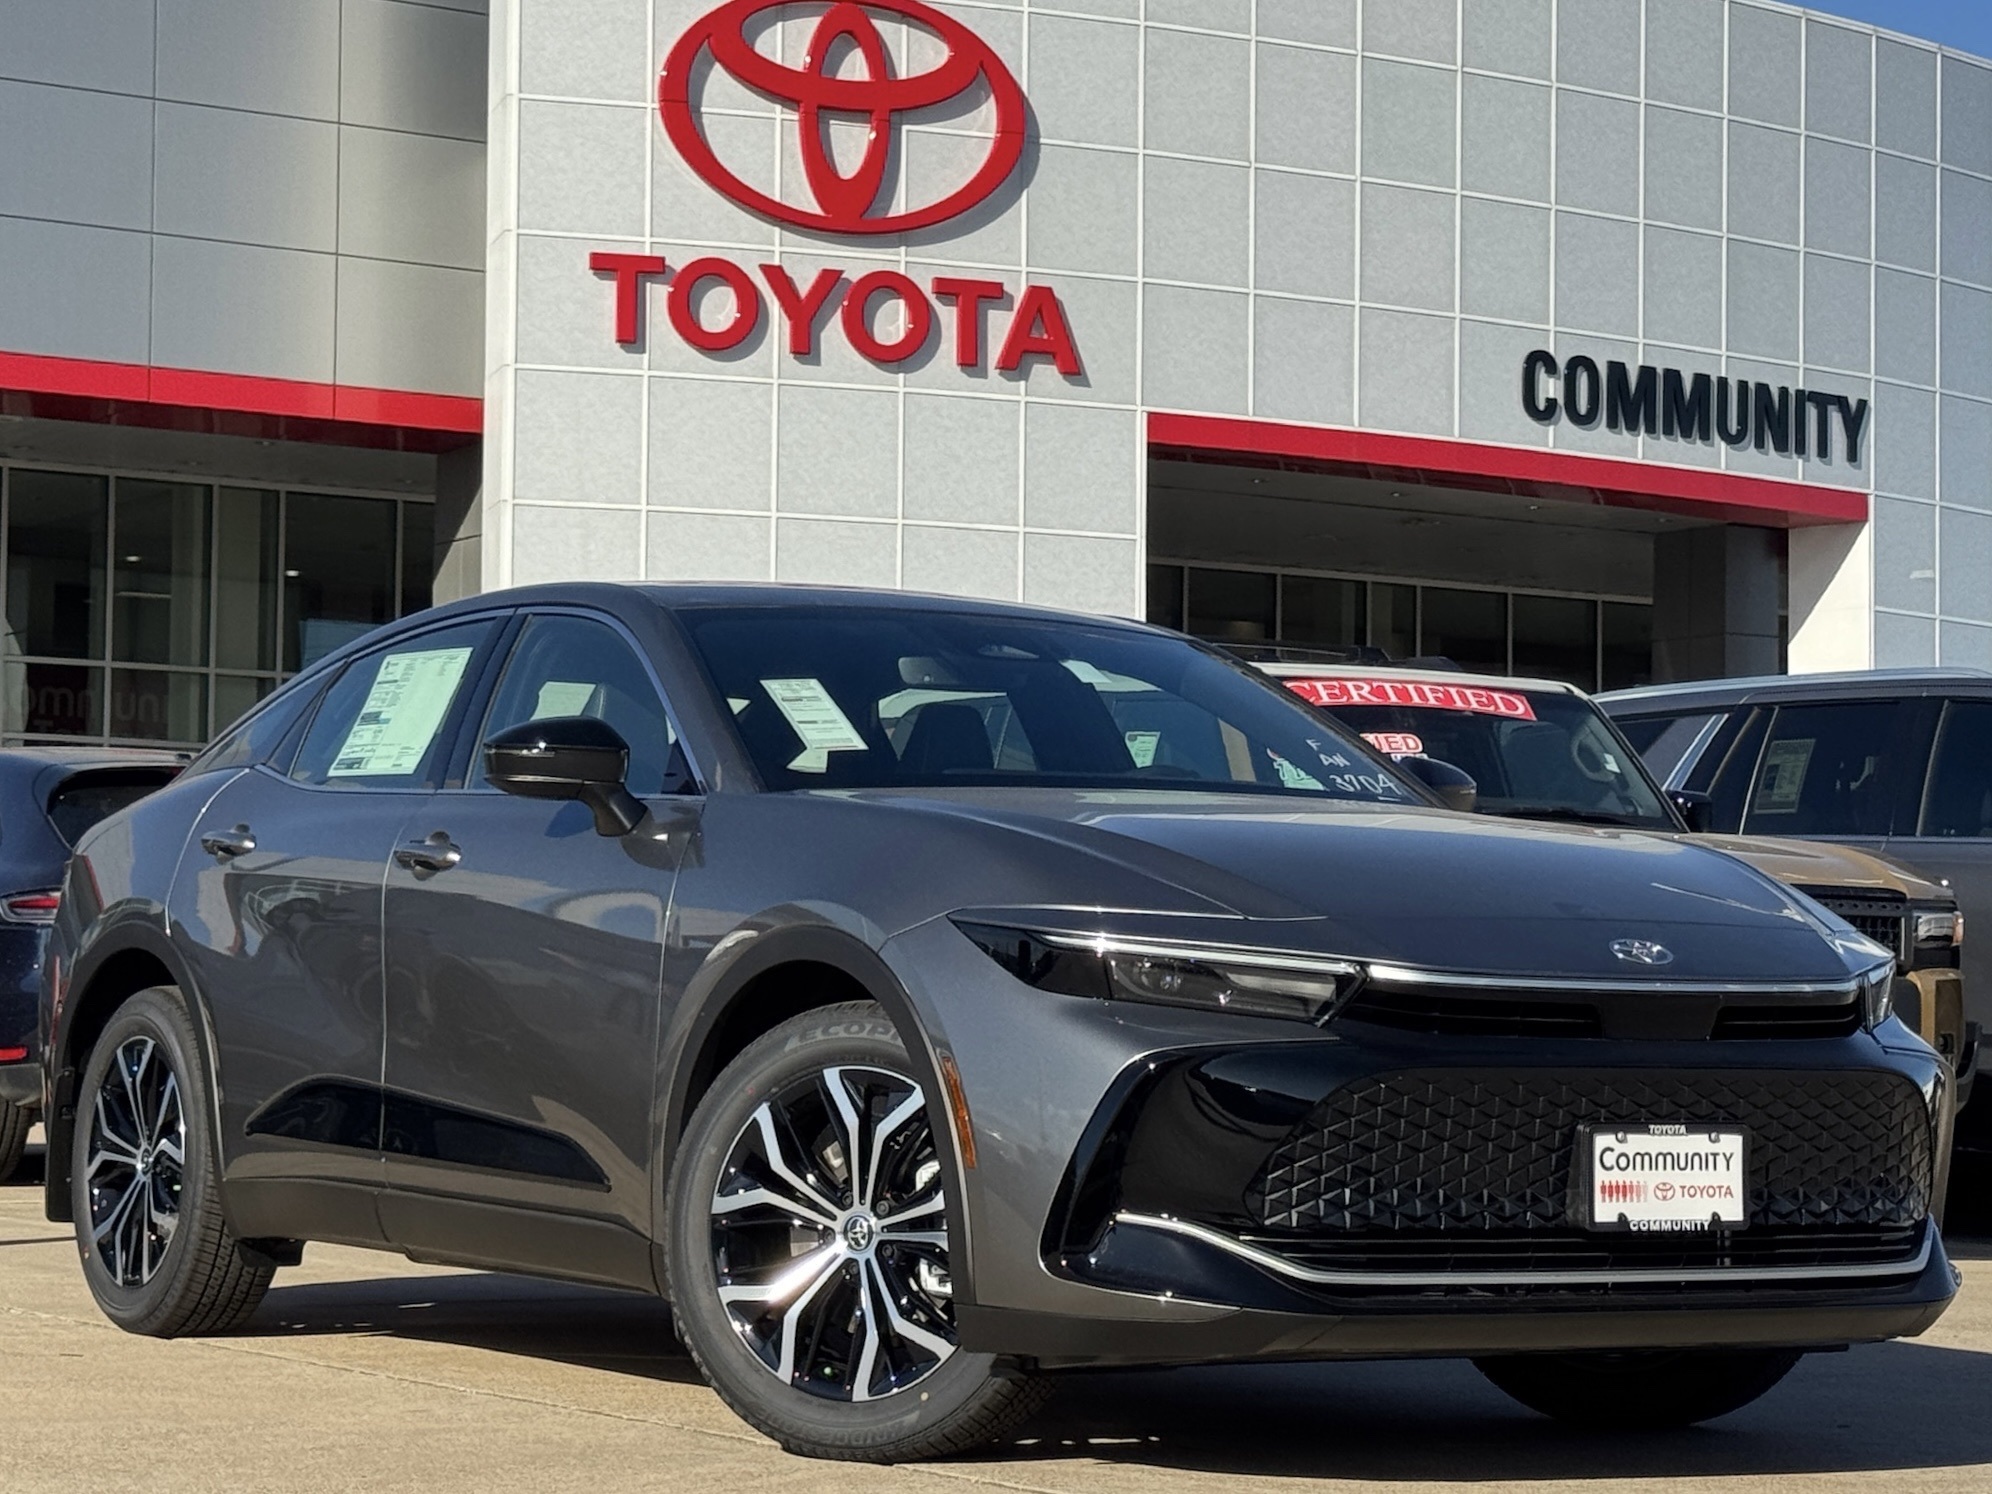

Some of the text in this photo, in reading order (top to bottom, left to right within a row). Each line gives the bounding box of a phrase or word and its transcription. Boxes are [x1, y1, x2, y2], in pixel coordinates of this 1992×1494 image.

[589, 252, 1082, 376] TOYOTA
[1522, 350, 1868, 463] COMMUNITY
[1364, 735, 1420, 751] IED
[1649, 1125, 1687, 1136] TOYOTA
[1679, 1185, 1734, 1199] TOYOTA
[1629, 1220, 1710, 1232] COMMUNITY
